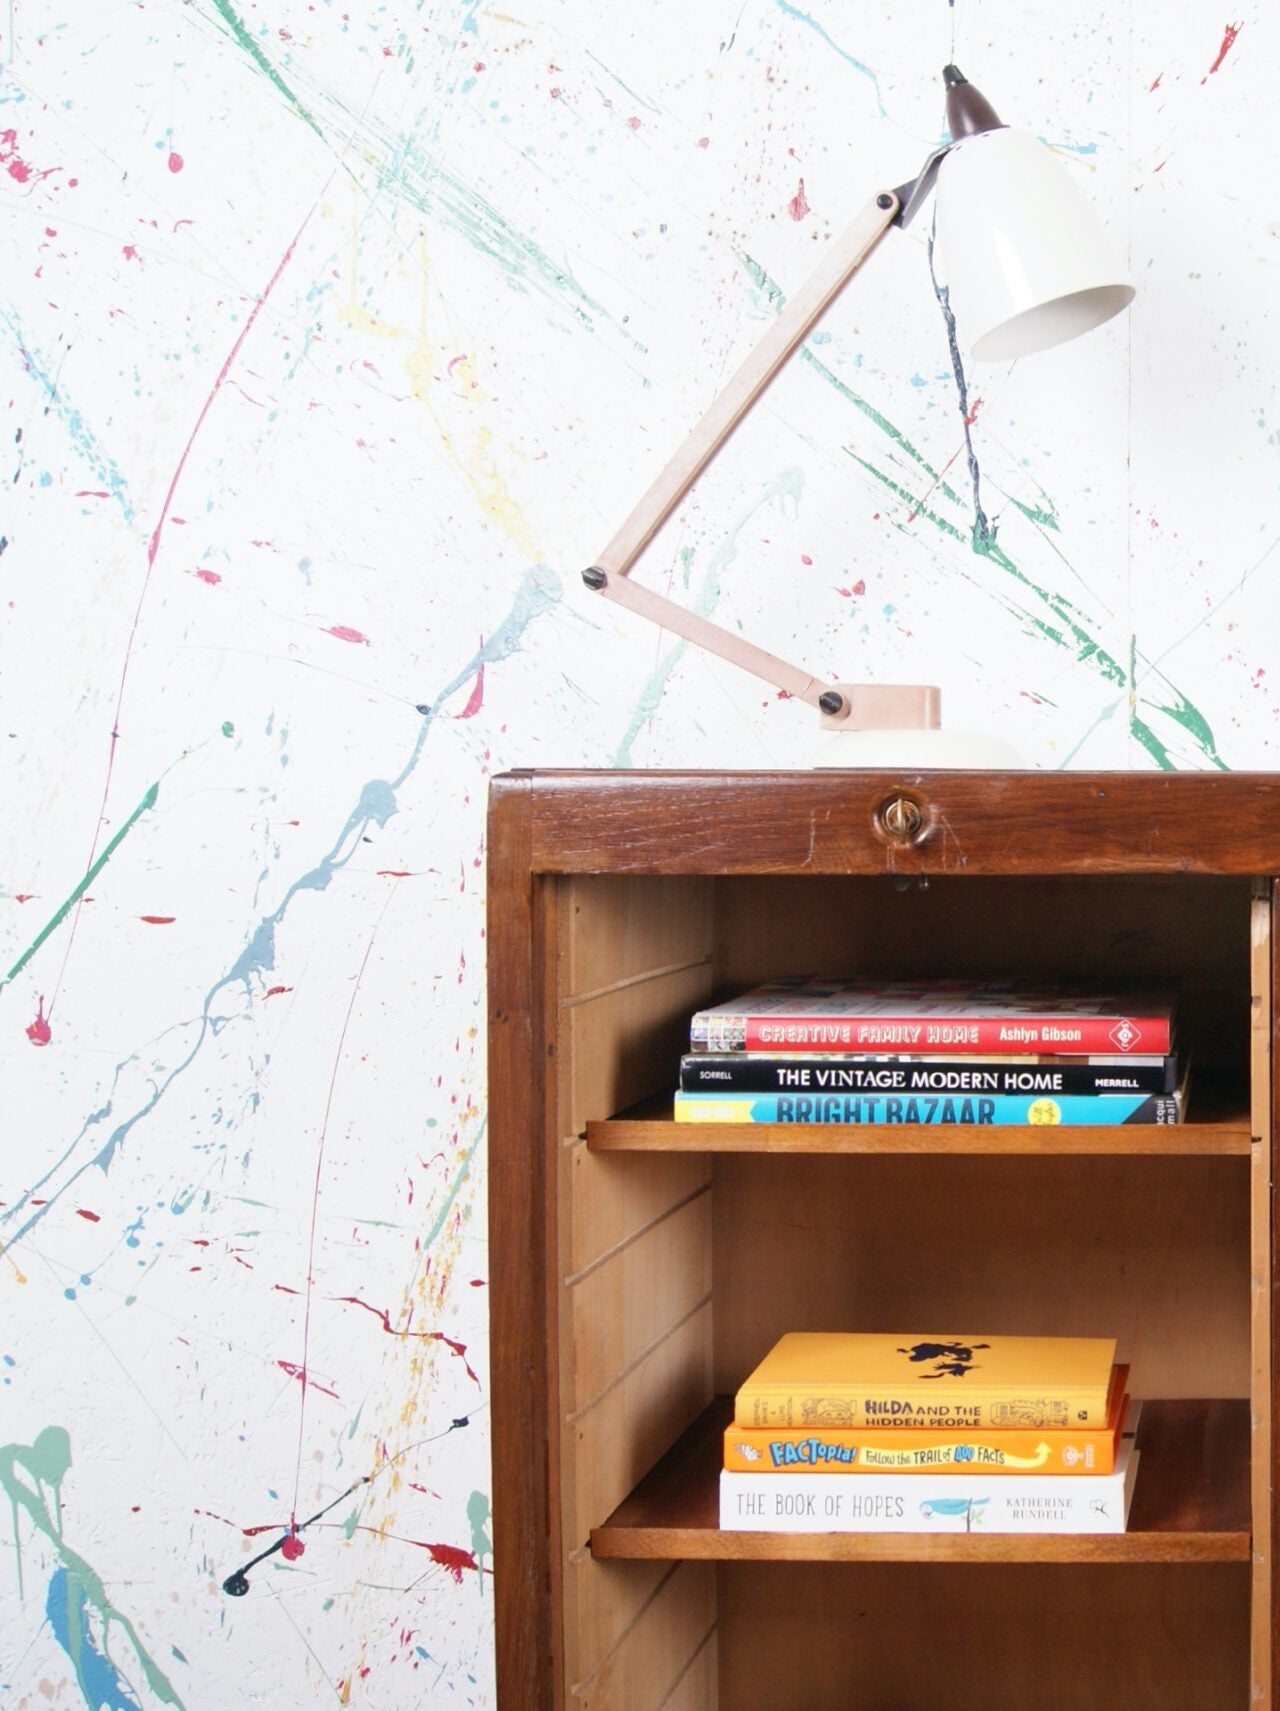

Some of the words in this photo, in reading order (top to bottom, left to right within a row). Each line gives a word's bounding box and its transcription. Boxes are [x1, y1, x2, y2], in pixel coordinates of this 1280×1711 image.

[759, 1025, 850, 1043] CREATIVE
[857, 1025, 921, 1044] FAMILY
[927, 1026, 979, 1044] HOME
[1000, 1026, 1038, 1044] Ashlyn
[1041, 1026, 1081, 1041] Gibson
[699, 1071, 732, 1080] SORRELL
[777, 1069, 811, 1085] THE
[816, 1070, 906, 1087] VINTAGE
[911, 1072, 999, 1089] MODERN
[1005, 1073, 1062, 1089] HOME
[1095, 1078, 1139, 1088] MERRELL
[777, 1097, 880, 1124] BRIGHT
[865, 1399, 913, 1415] HILDA
[916, 1406, 950, 1416] AND
[954, 1406, 981, 1416] THE
[866, 1417, 924, 1426] HIDDEN
[930, 1417, 981, 1427] PEOPLE
[914, 1449, 943, 1464] TRAIL
[737, 1493, 766, 1515] THE
[776, 1493, 816, 1515] BOOK
[824, 1495, 844, 1516] OF
[852, 1495, 904, 1517] HOPES
[1006, 1498, 1072, 1508] KATHERINE
[1012, 1509, 1067, 1519] RUNDELL
